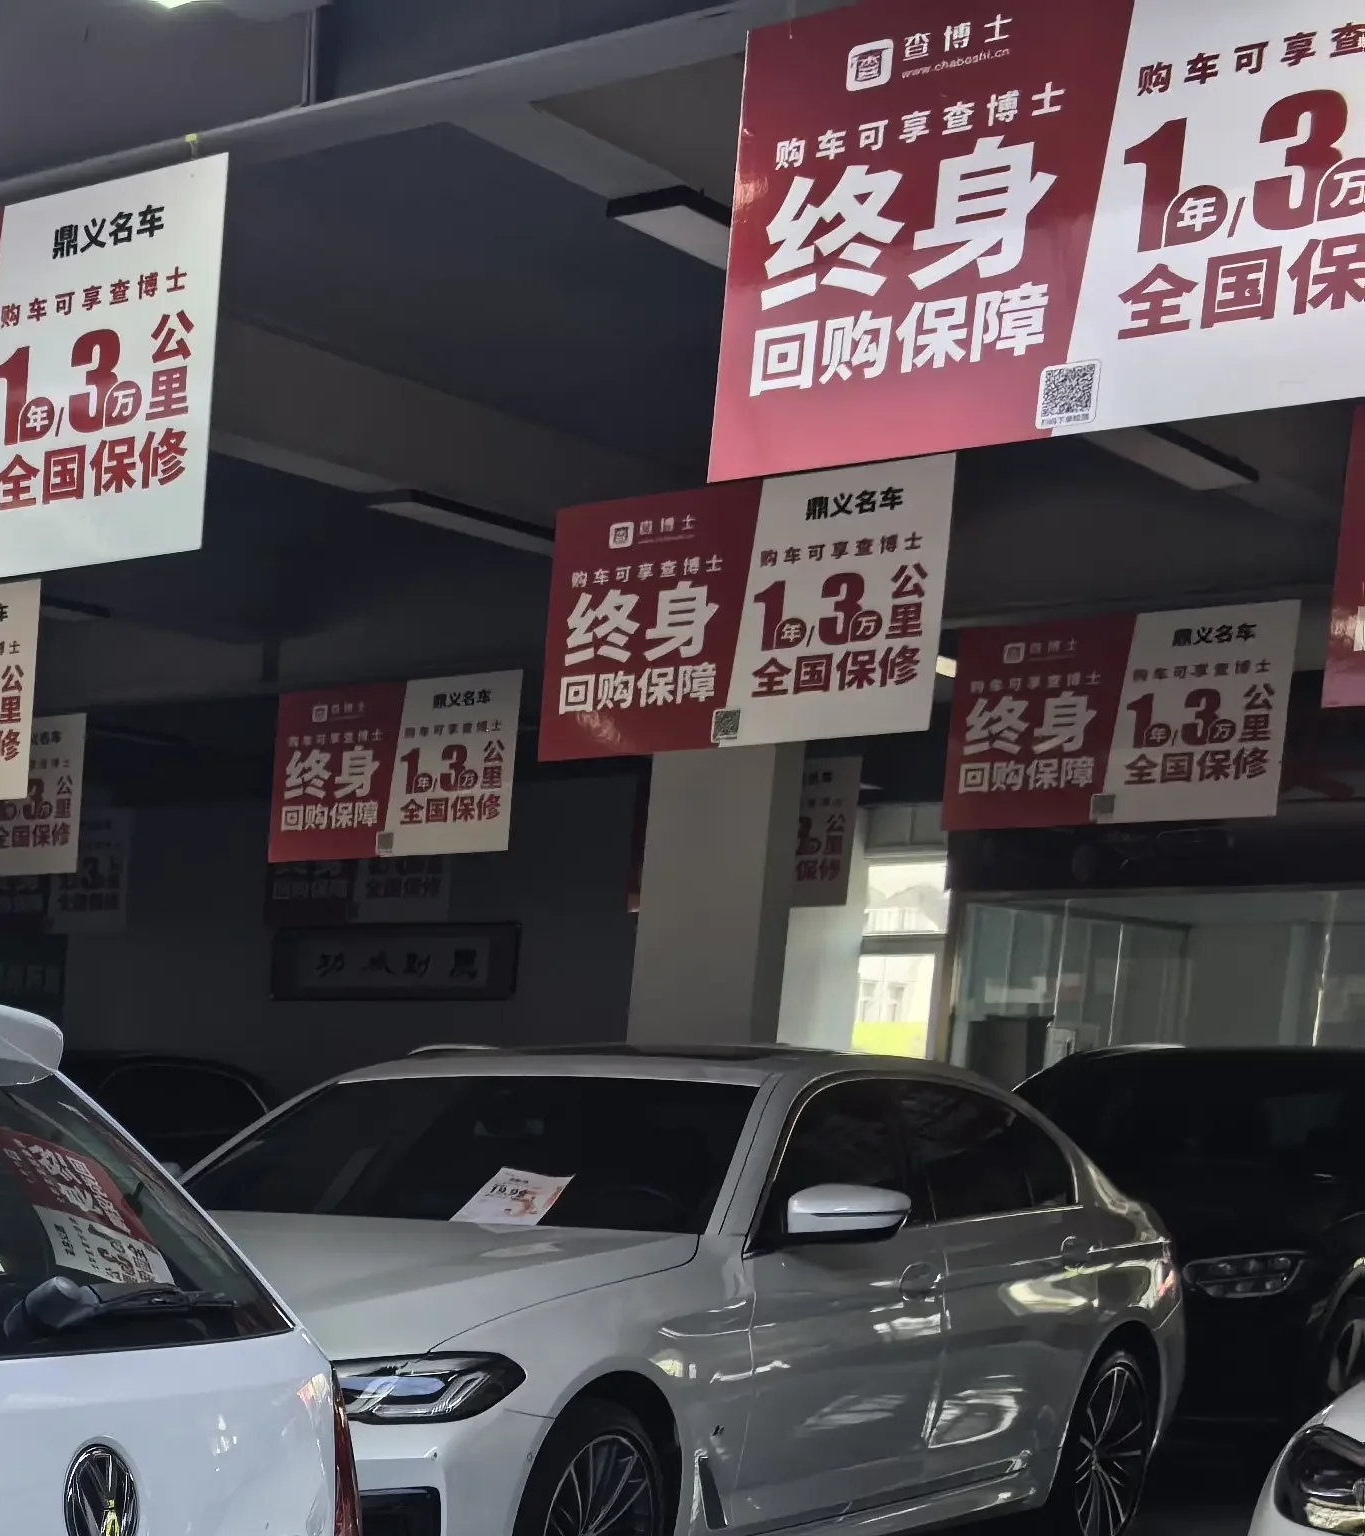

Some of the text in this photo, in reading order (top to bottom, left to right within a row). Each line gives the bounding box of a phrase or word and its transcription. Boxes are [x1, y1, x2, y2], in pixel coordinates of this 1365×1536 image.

[902, 48, 1010, 79] www.chaboshi.cn
[903, 13, 1013, 62] 查博士
[1139, 20, 1365, 96] 购车可享查
[775, 81, 1065, 171] 购车可享查博士
[52, 204, 165, 260] 鼎义名车
[760, 135, 1058, 312] 终身
[0, 266, 188, 329] 购车可享查博士
[1119, 233, 1365, 340] 全国保
[749, 281, 1050, 398] 回购保障
[805, 486, 904, 521] 鼎义名车
[571, 553, 724, 589] 购车可享查博士
[759, 531, 923, 567] 购车可享查博士
[563, 580, 721, 667] 终身
[556, 661, 717, 715] 回购保障
[751, 644, 921, 698] 全国保修
[962, 690, 1099, 757] 终身
[283, 744, 381, 801] 终身
[956, 755, 1095, 795] 回购保障
[1124, 746, 1269, 786] 全国保修
[279, 799, 379, 833] 回购保障
[399, 792, 502, 825] 全国保修
